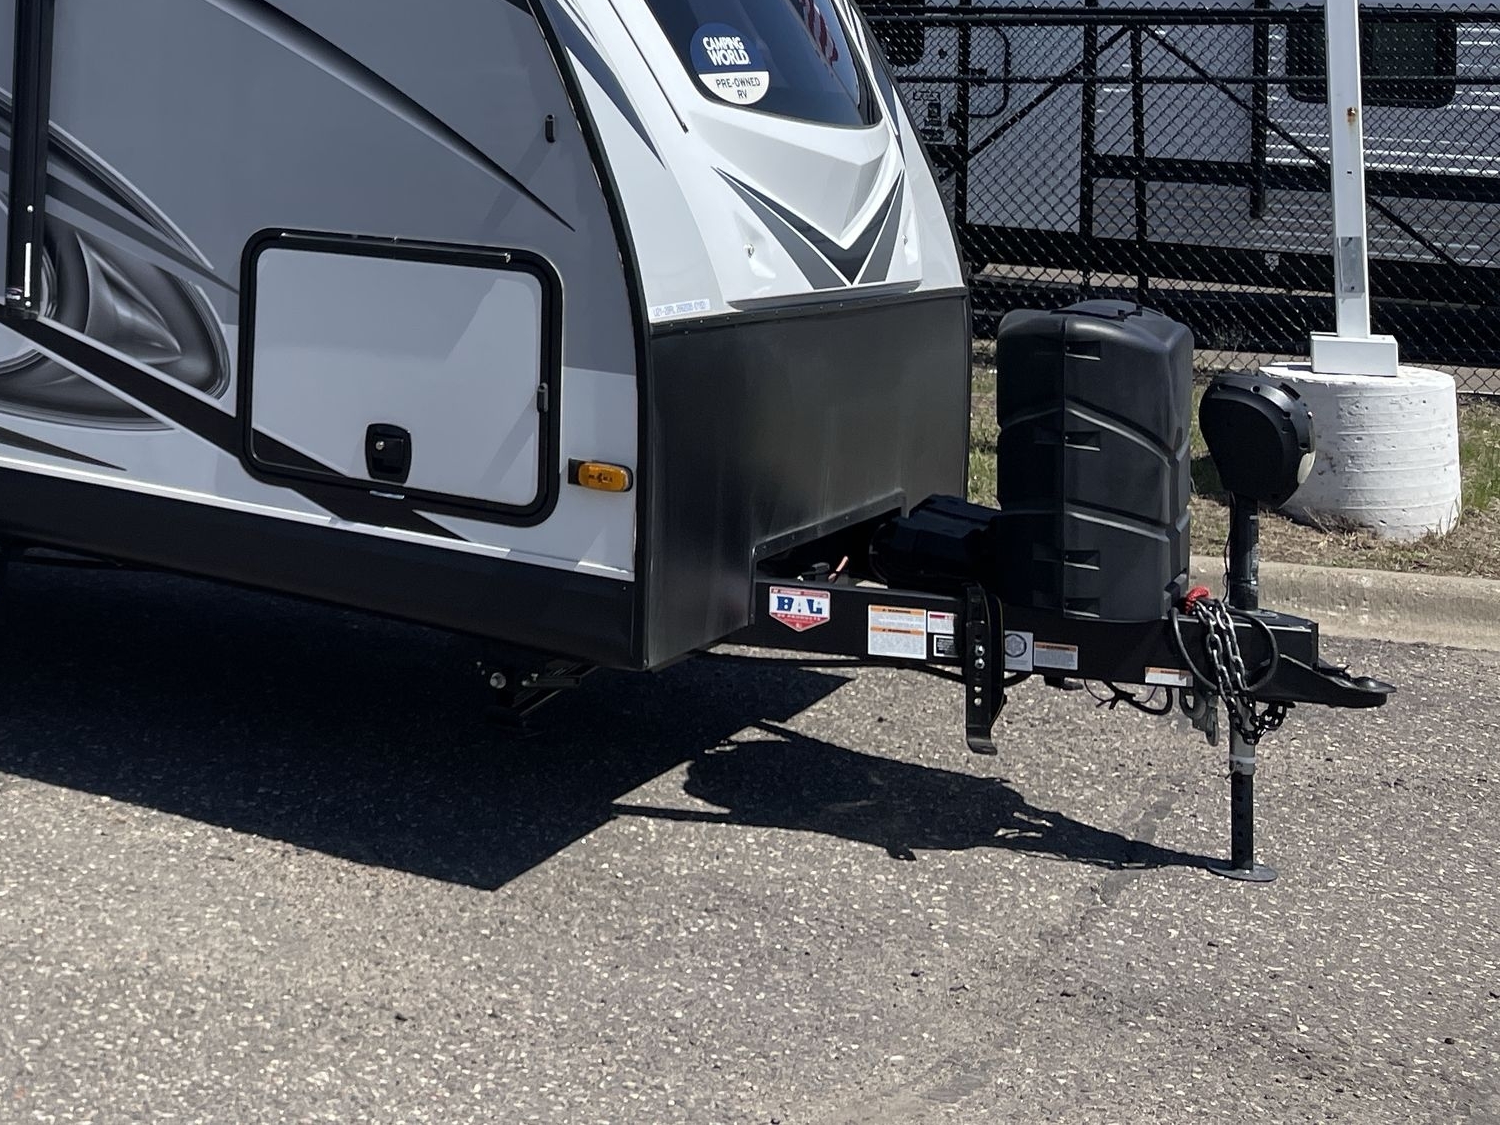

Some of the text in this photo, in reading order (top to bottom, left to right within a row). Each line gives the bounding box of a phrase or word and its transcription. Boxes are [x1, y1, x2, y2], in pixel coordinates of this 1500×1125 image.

[702, 36, 745, 51] CAMPING
[706, 49, 750, 66] WORLD
[715, 76, 761, 89] PRE-OWNED
[736, 89, 748, 100] RV
